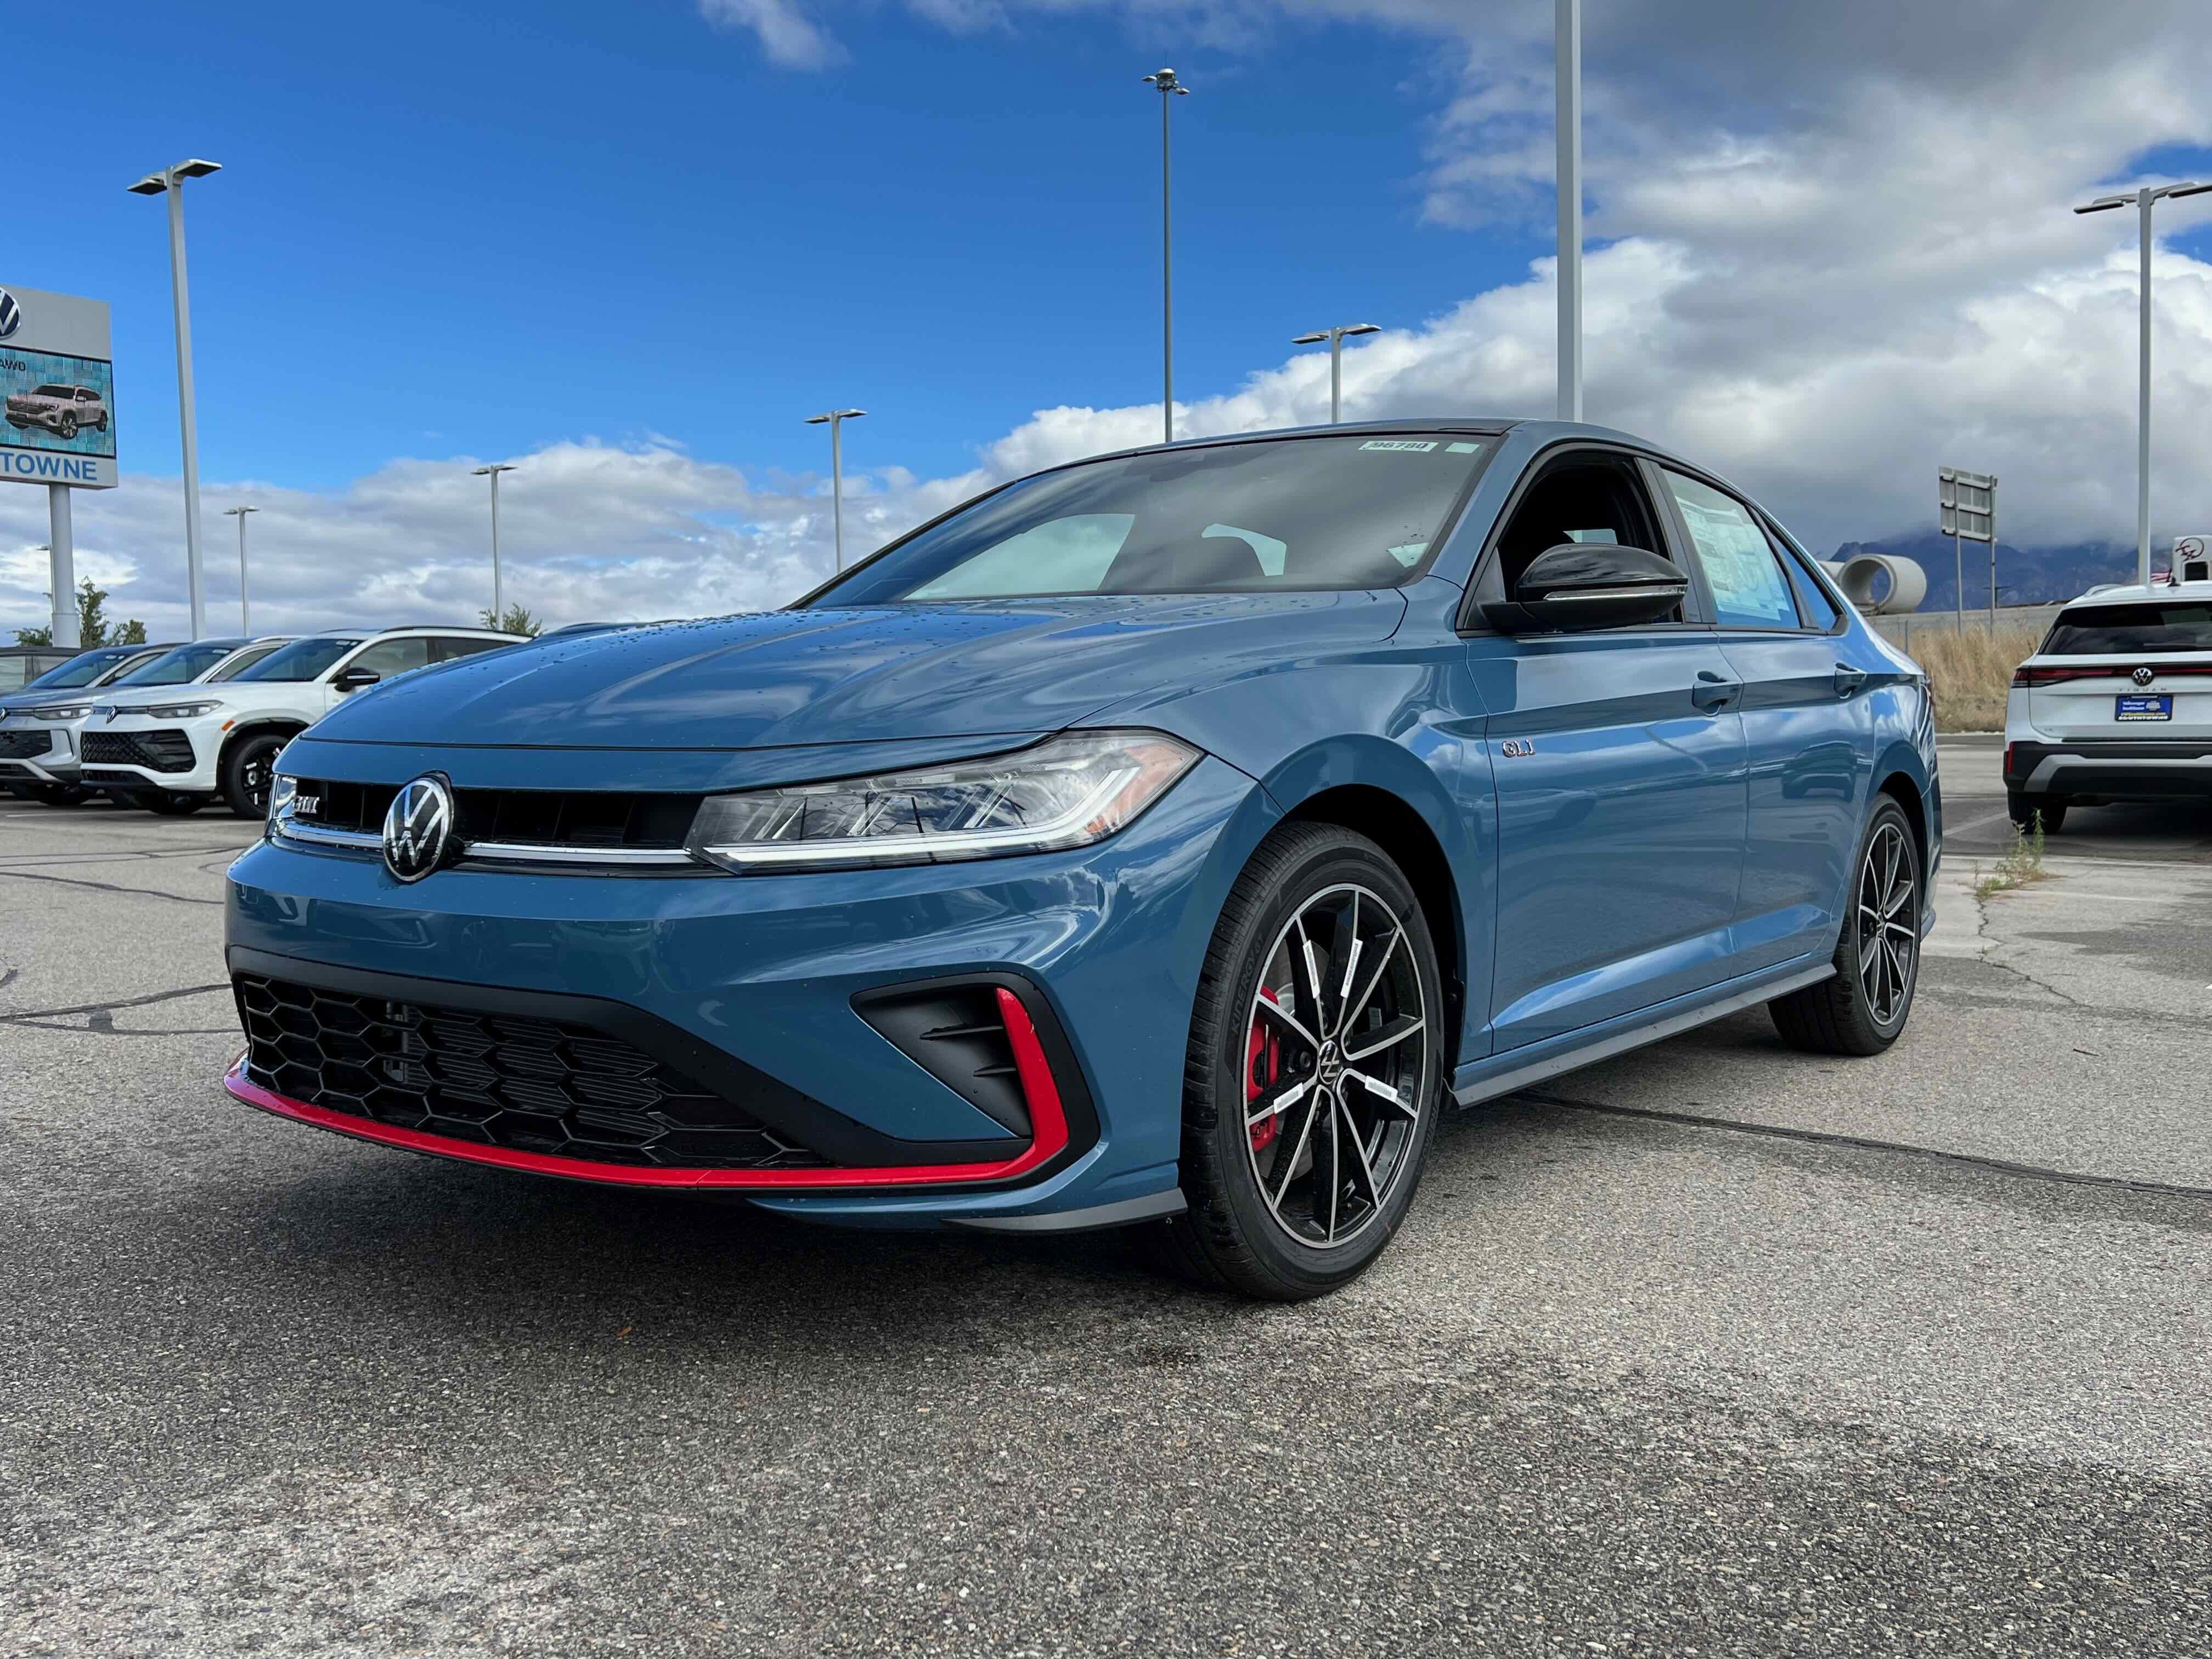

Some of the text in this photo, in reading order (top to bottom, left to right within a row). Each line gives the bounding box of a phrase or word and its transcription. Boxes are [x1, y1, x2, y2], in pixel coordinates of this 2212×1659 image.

[0, 452, 97, 481] TOWNE
[1502, 739, 1536, 758] GLI
[383, 776, 452, 884] VW
